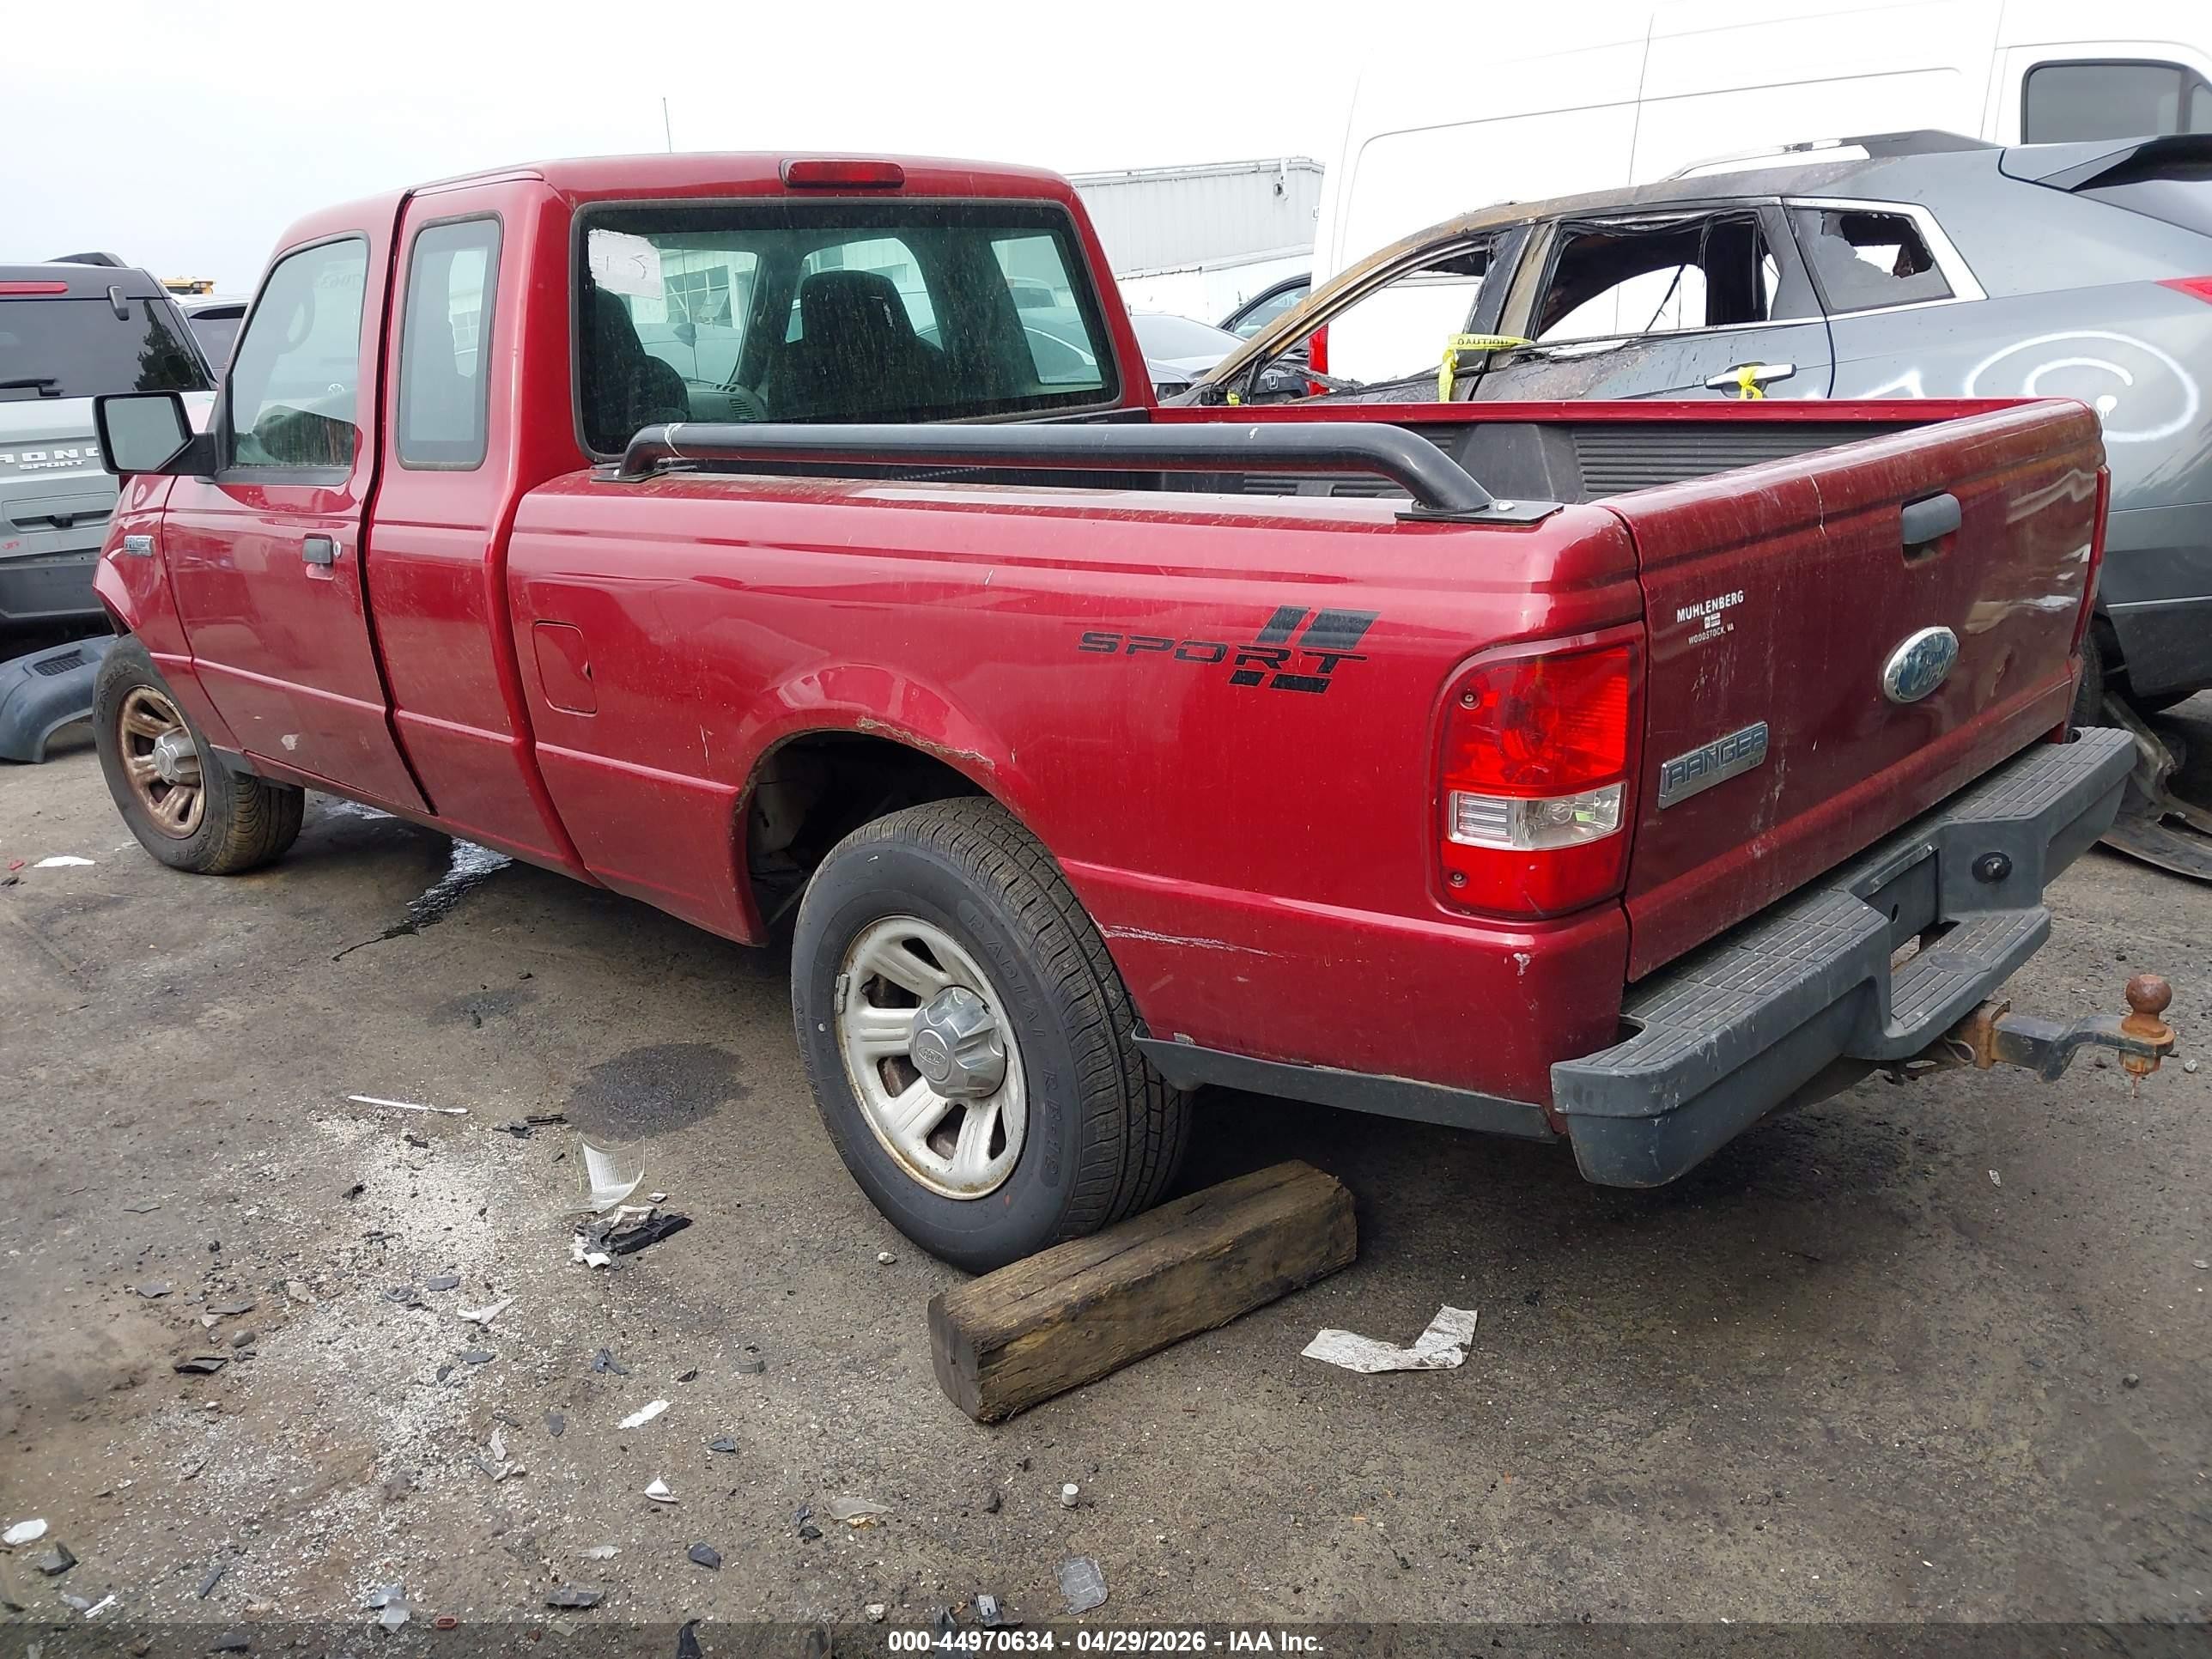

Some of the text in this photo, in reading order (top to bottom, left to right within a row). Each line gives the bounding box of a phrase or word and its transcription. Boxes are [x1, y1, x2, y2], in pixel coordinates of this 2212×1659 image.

[19, 459, 86, 471] SPORT
[1676, 589, 1745, 623] MUHLENBERG
[1688, 623, 1735, 646] WOODSTOCK, VA
[1078, 631, 1368, 674] SPORT
[1667, 726, 1768, 792] RANGER
